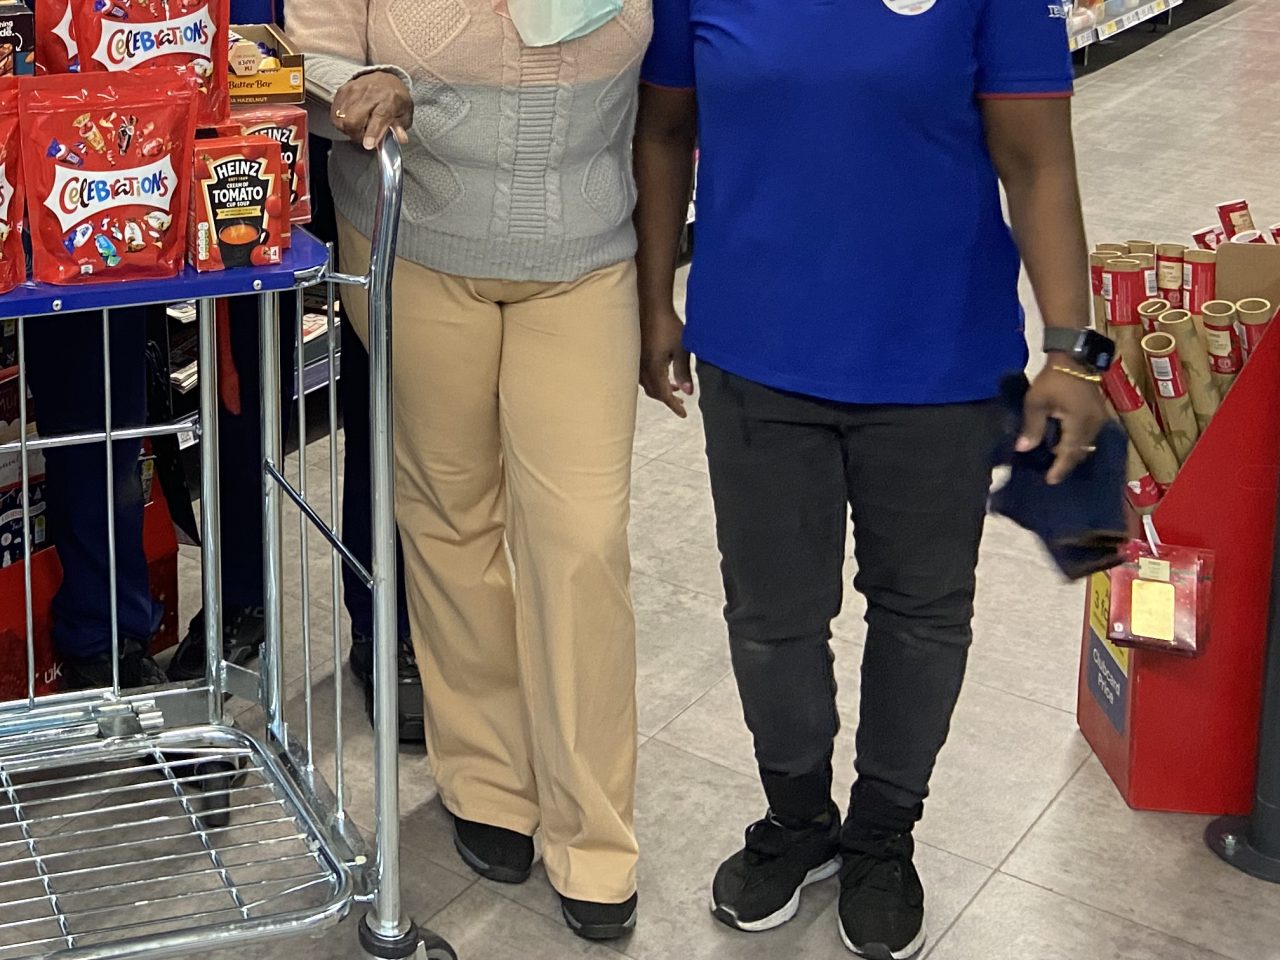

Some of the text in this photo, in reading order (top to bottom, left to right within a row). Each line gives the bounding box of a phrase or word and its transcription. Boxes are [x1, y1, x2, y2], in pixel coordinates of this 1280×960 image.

[229, 79, 272, 89] Butter Bar
[255, 128, 290, 142] EINZ
[217, 161, 259, 179] HEINZ
[212, 186, 263, 203] TOMATO
[272, 248, 277, 257] 4
[1093, 648, 1120, 697] Clubcard
[1097, 673, 1114, 705] Price
